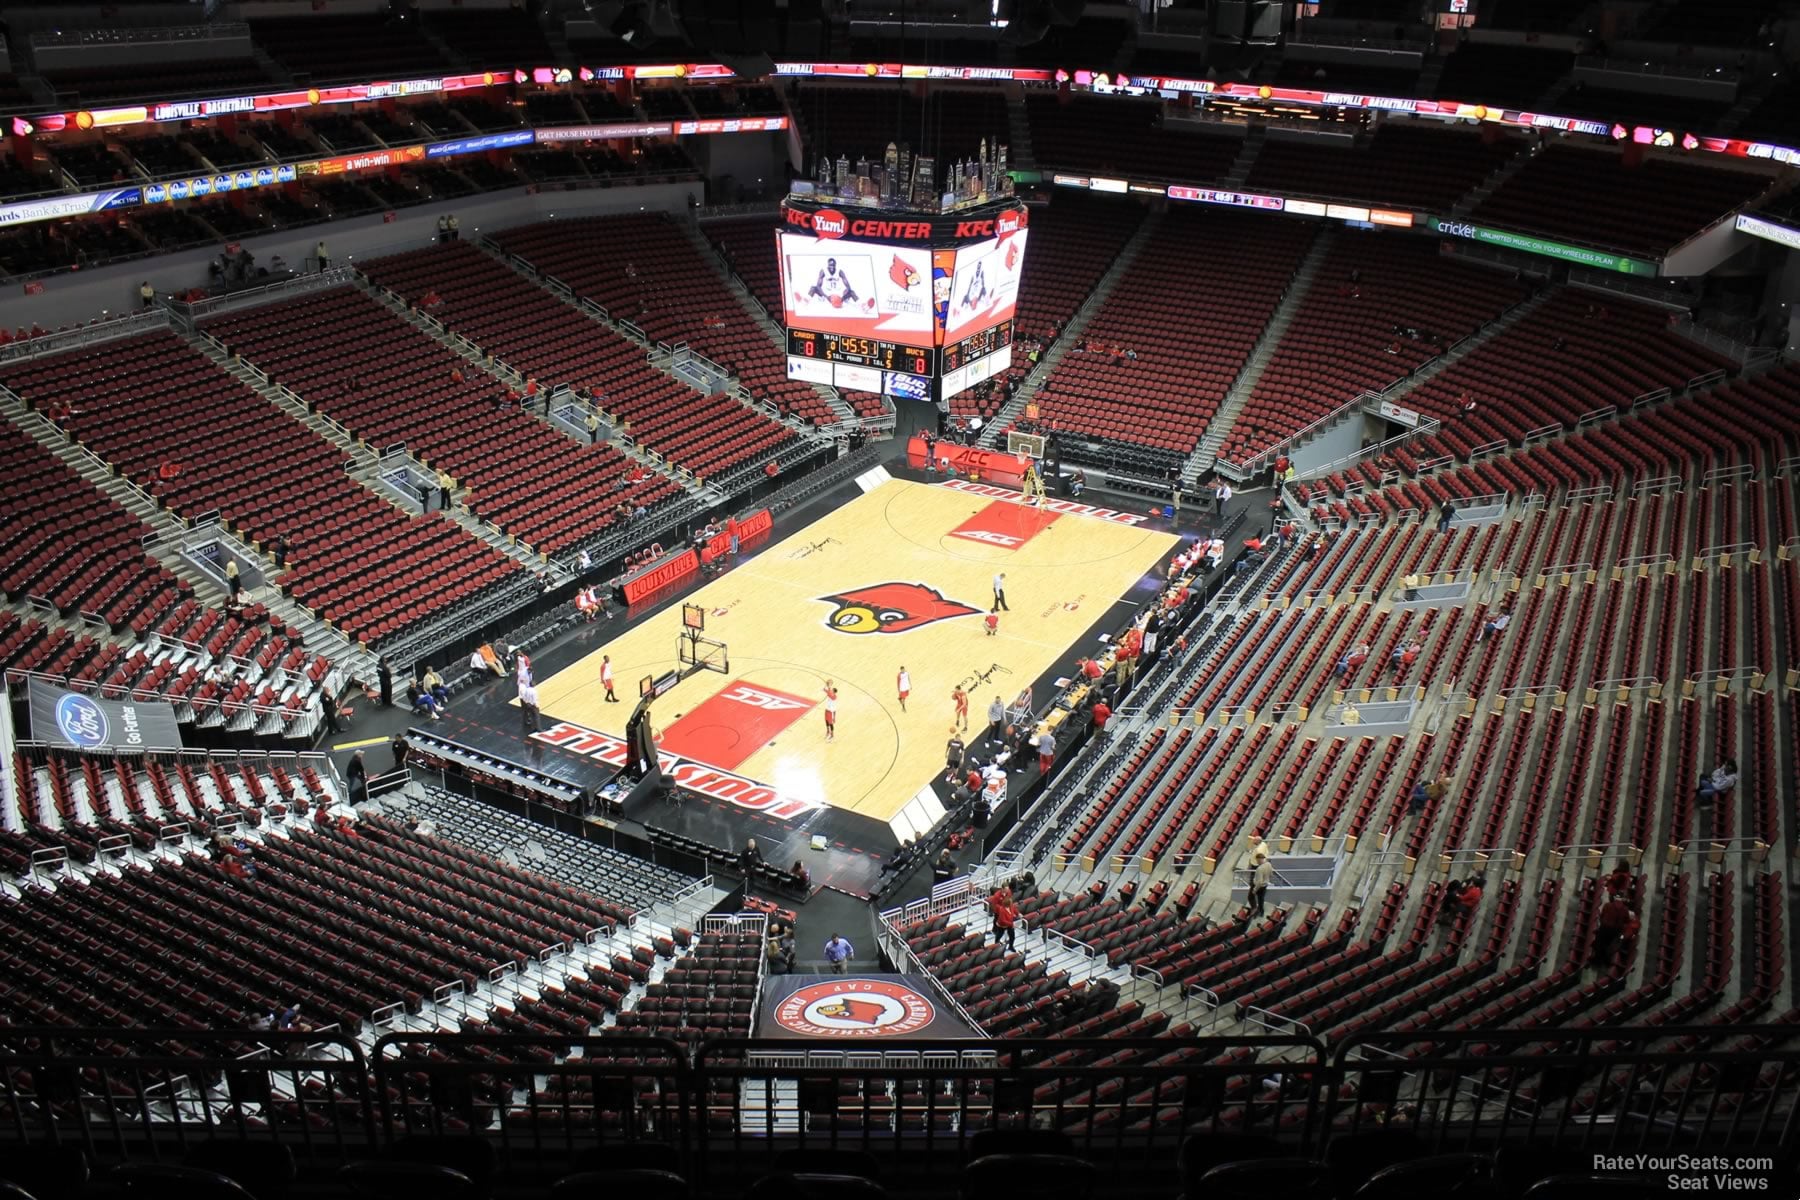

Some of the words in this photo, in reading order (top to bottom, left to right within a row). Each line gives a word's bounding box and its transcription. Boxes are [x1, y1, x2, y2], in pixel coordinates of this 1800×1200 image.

[155, 103, 200, 120] LOUISVILLE
[206, 98, 254, 114] BASKETBALL
[556, 131, 579, 139] HOUSE
[580, 129, 601, 138] HOTEL
[346, 161, 353, 170] a
[355, 153, 390, 169] win-win
[22, 206, 49, 219] Bank
[52, 205, 60, 214] &
[61, 201, 90, 213] Trust
[787, 208, 810, 228] KFC
[814, 215, 845, 233] Yum!
[851, 220, 932, 238] CENTER
[955, 220, 994, 238] KFC
[1438, 221, 1477, 239] cricket
[1480, 231, 1512, 243] UNLIMITED
[1512, 238, 1531, 247] MUSIC
[1543, 245, 1560, 254] YOUR
[1562, 249, 1594, 261] WIRELESS
[1595, 254, 1613, 265] PLAN
[805, 341, 814, 356] 0
[830, 341, 836, 350] 0
[841, 337, 877, 355] 45:51
[887, 350, 893, 359] 0
[916, 358, 925, 374] 0
[890, 381, 927, 397] LIGHT
[894, 373, 926, 389] BUD
[954, 449, 992, 466] ACC
[955, 530, 1024, 546] ACC
[632, 553, 693, 600] LOUISVILLE
[720, 686, 811, 710] ACC
[64, 702, 101, 740] Ford
[121, 705, 140, 733] Further
[126, 732, 142, 744] Go
[782, 997, 807, 1021] FUND
[885, 994, 928, 1032] CARDINAL
[788, 1020, 881, 1036] ATHLETIC
